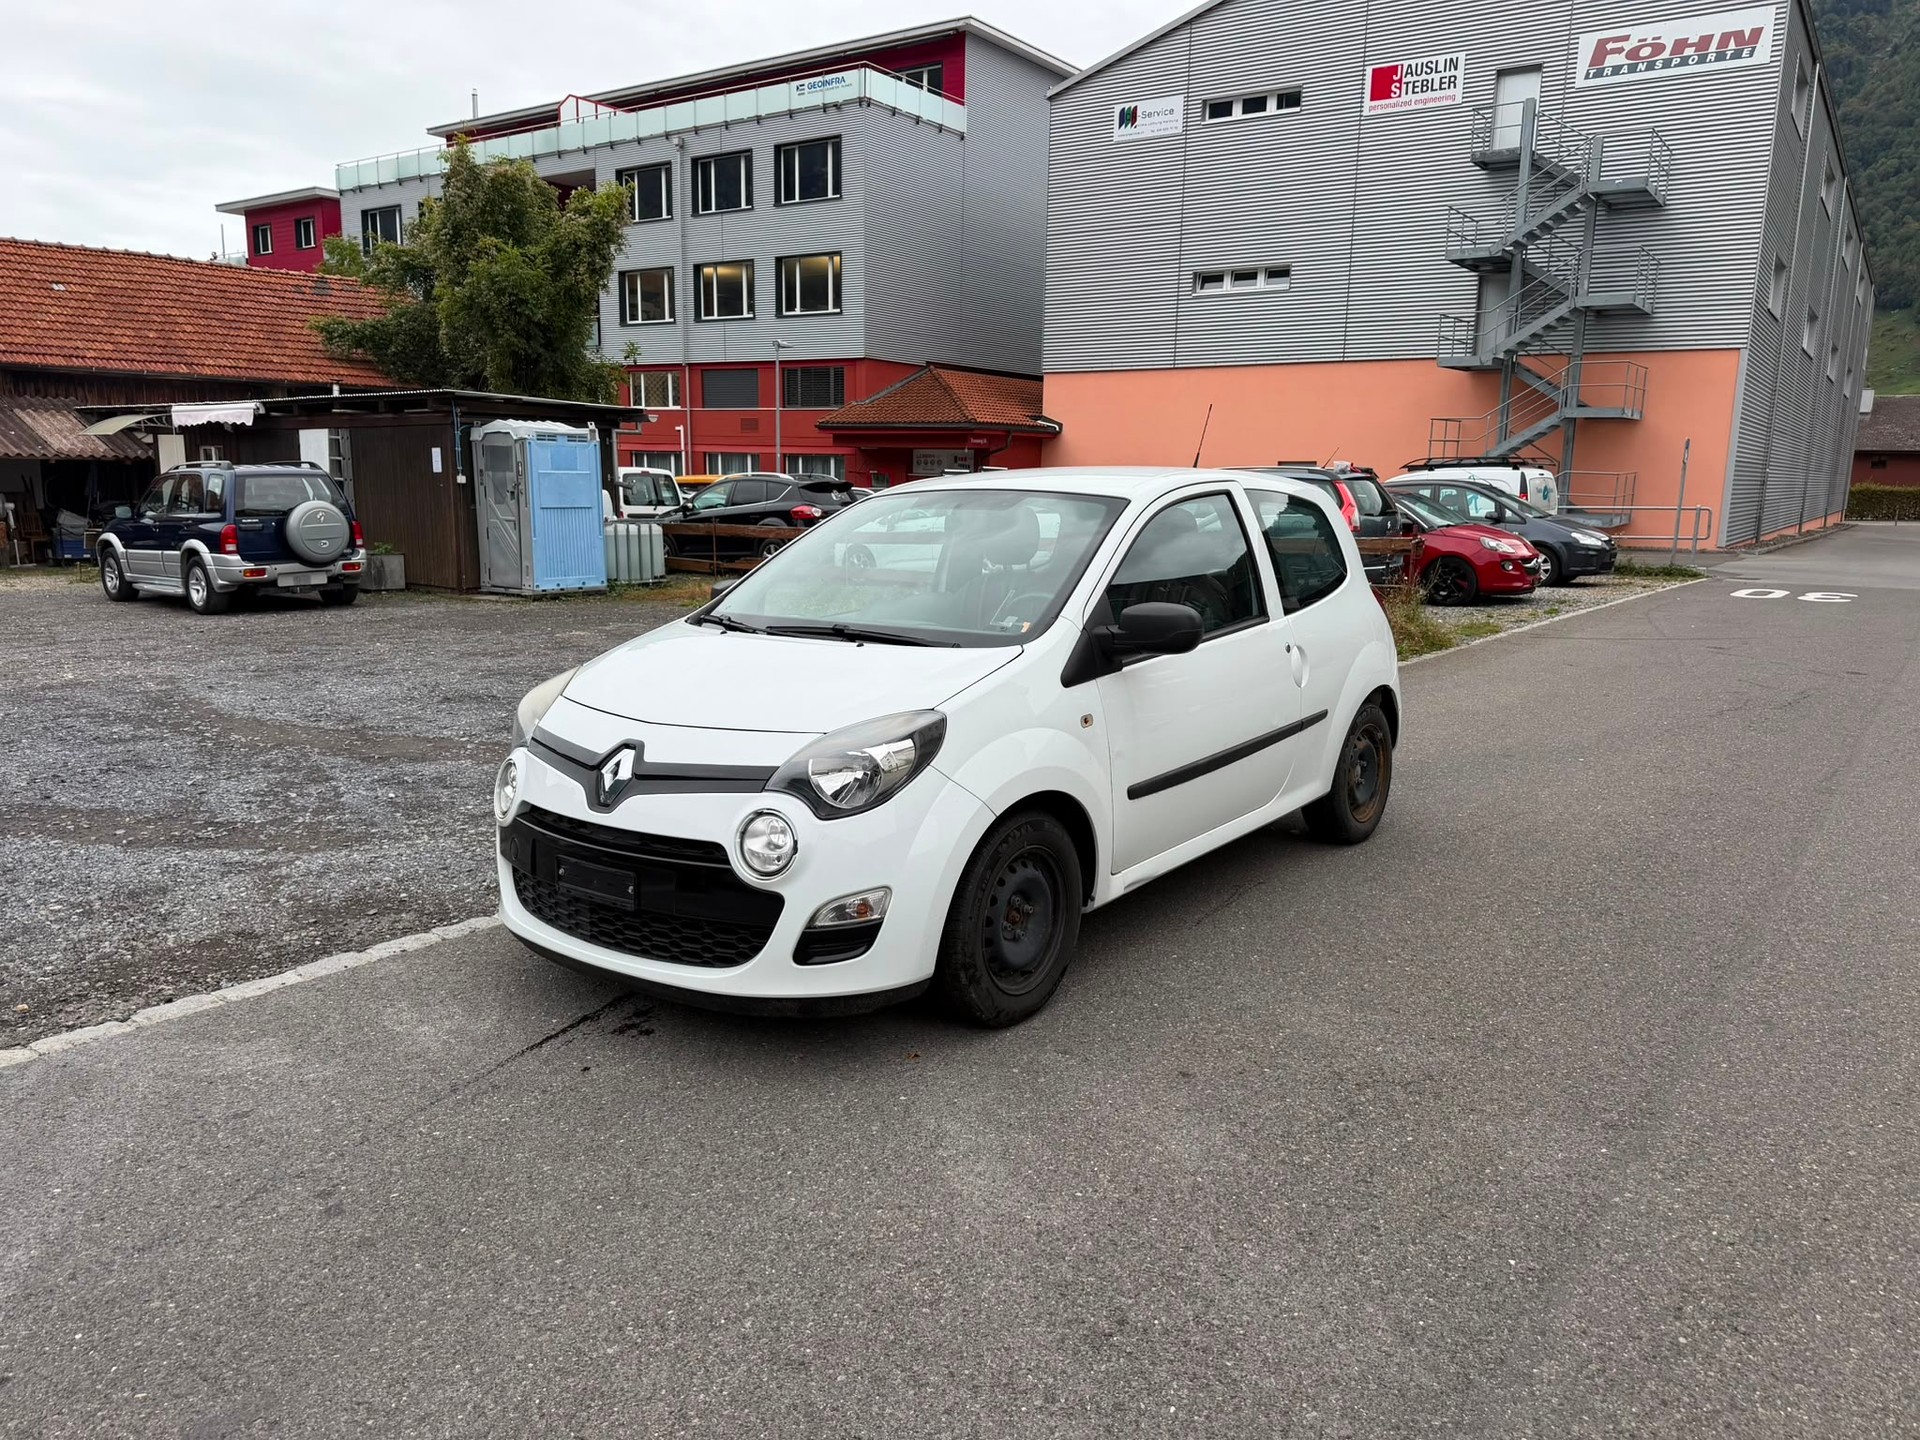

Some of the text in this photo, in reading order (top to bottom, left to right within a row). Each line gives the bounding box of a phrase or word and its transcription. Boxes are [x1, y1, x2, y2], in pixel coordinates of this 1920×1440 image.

[1588, 26, 1764, 68] FÖHN
[1392, 56, 1459, 80] JAUSLIN
[1587, 47, 1753, 79] TRANSPORTE
[807, 75, 846, 90] GEOINFRA
[1390, 74, 1458, 98] STEBLER
[1368, 94, 1456, 112] personalized engineering
